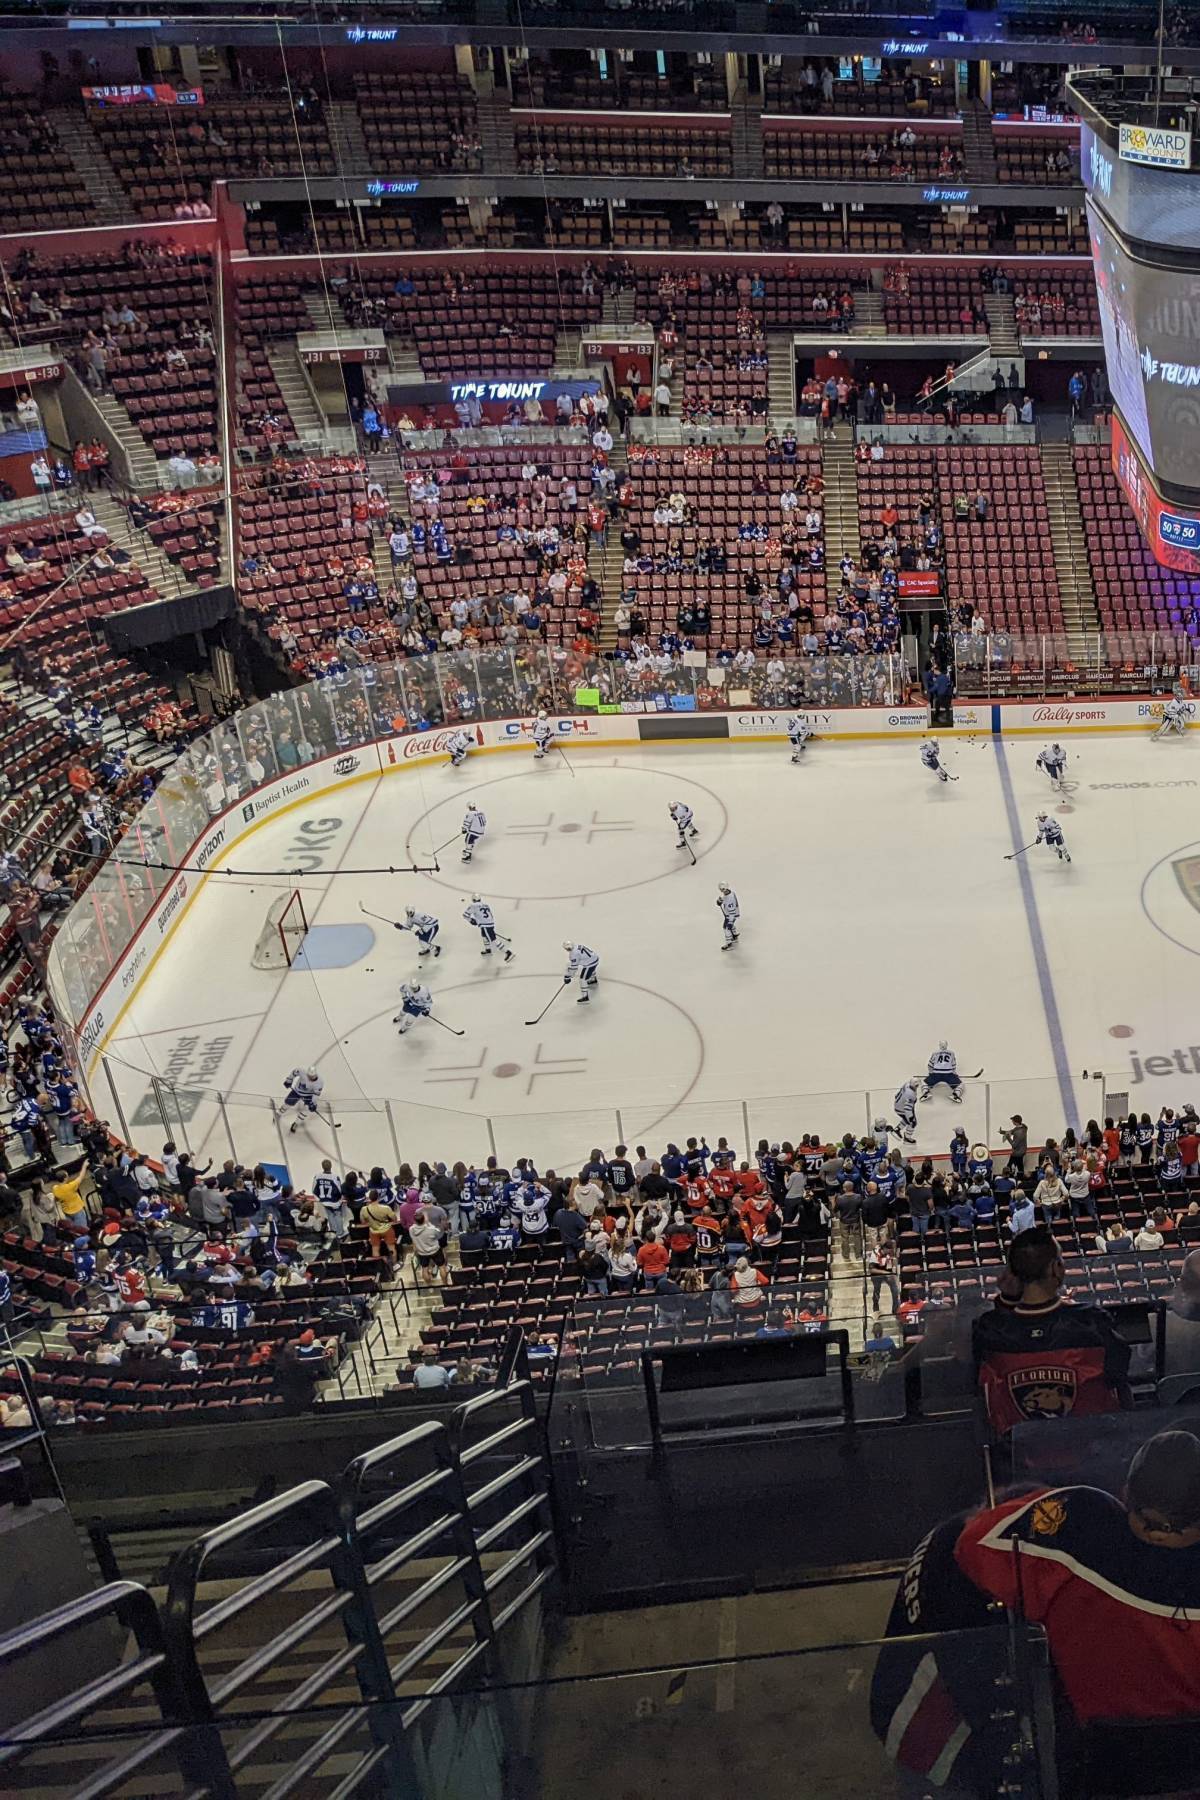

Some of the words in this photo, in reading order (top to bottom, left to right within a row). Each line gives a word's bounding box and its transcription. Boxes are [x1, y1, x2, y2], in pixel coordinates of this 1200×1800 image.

[1120, 127, 1186, 150] BROWARD
[1122, 152, 1182, 165] FLORIDA
[1146, 148, 1185, 158] COUNTY
[364, 349, 380, 360] 132
[588, 344, 602, 354] 132
[637, 344, 652, 354] 133
[308, 352, 323, 362] 131
[43, 366, 60, 378] 130
[1162, 521, 1172, 532] 50
[1181, 527, 1196, 537] 50
[738, 715, 778, 725] CITY
[805, 714, 832, 724] ITY
[1033, 706, 1074, 724] Bally
[1075, 711, 1105, 720] SPORTS
[333, 757, 359, 773] NHL
[1089, 779, 1198, 790] socios.com
[254, 791, 281, 813] Baptist
[281, 777, 310, 798] Health
[195, 829, 225, 871] verizon
[184, 1034, 234, 1087] Health
[805, 1158, 823, 1171] 70
[613, 1172, 626, 1185] 16
[318, 1185, 333, 1199] 17
[221, 1312, 238, 1331] 91
[1013, 1369, 1070, 1385] FLORIDA
